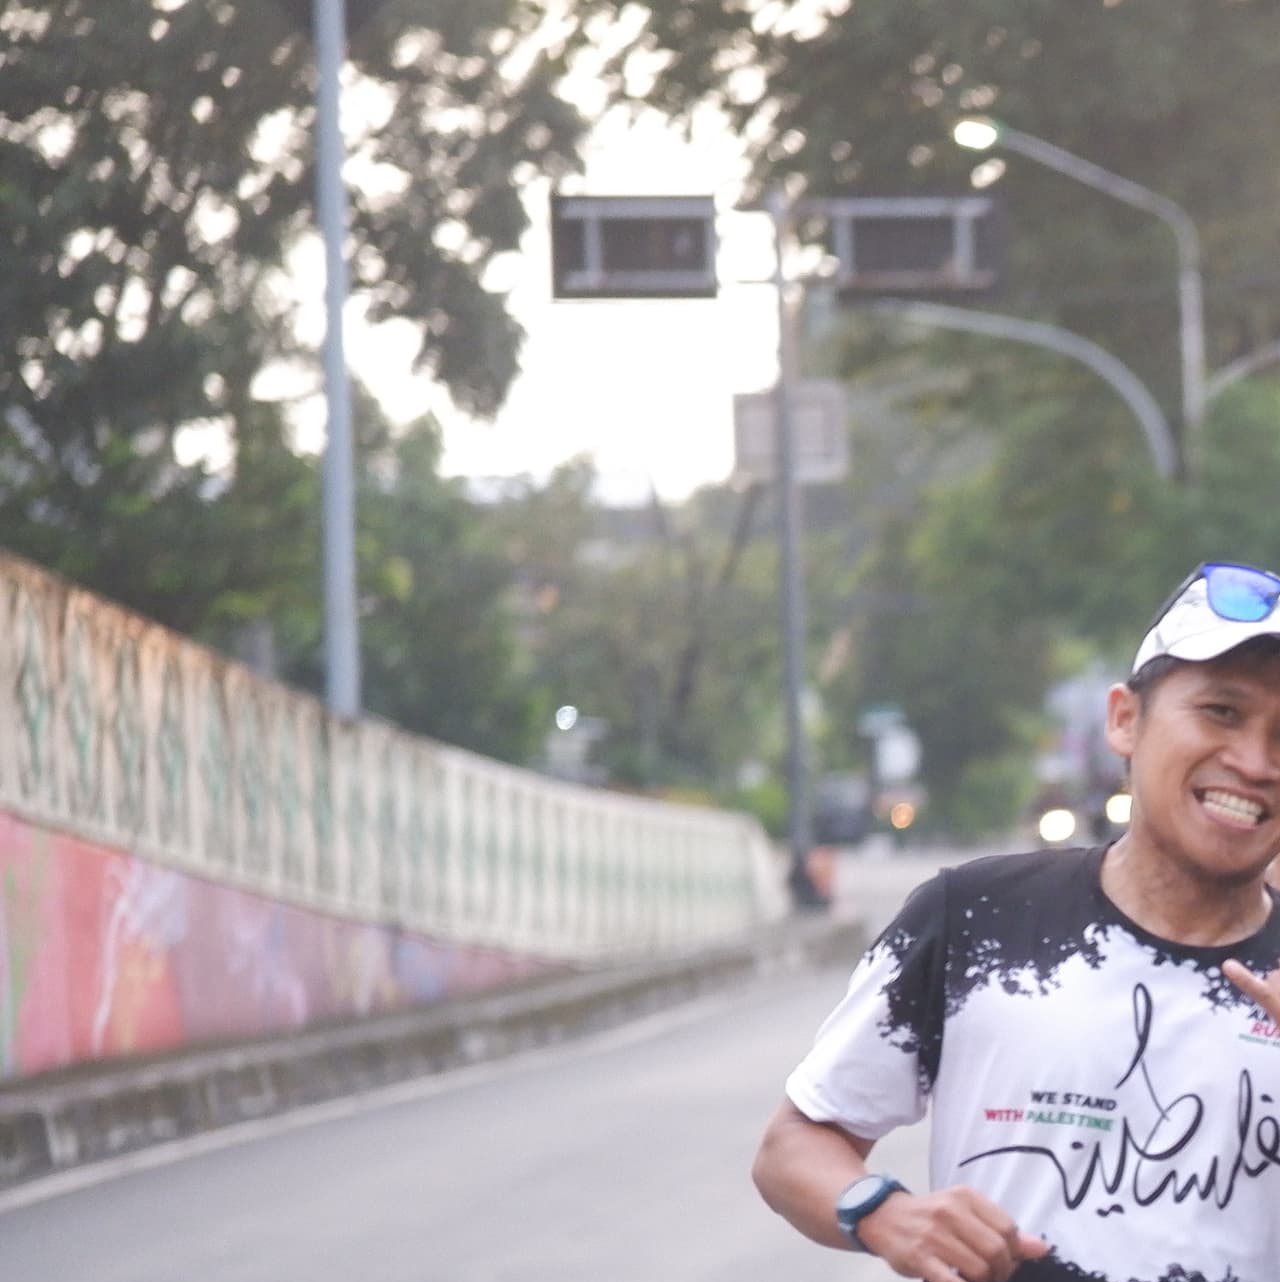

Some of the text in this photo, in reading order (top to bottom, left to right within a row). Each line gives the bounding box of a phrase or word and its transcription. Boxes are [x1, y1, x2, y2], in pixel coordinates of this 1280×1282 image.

[1031, 1091, 1117, 1111] WE STAND
[984, 1108, 1023, 1122] WITH
